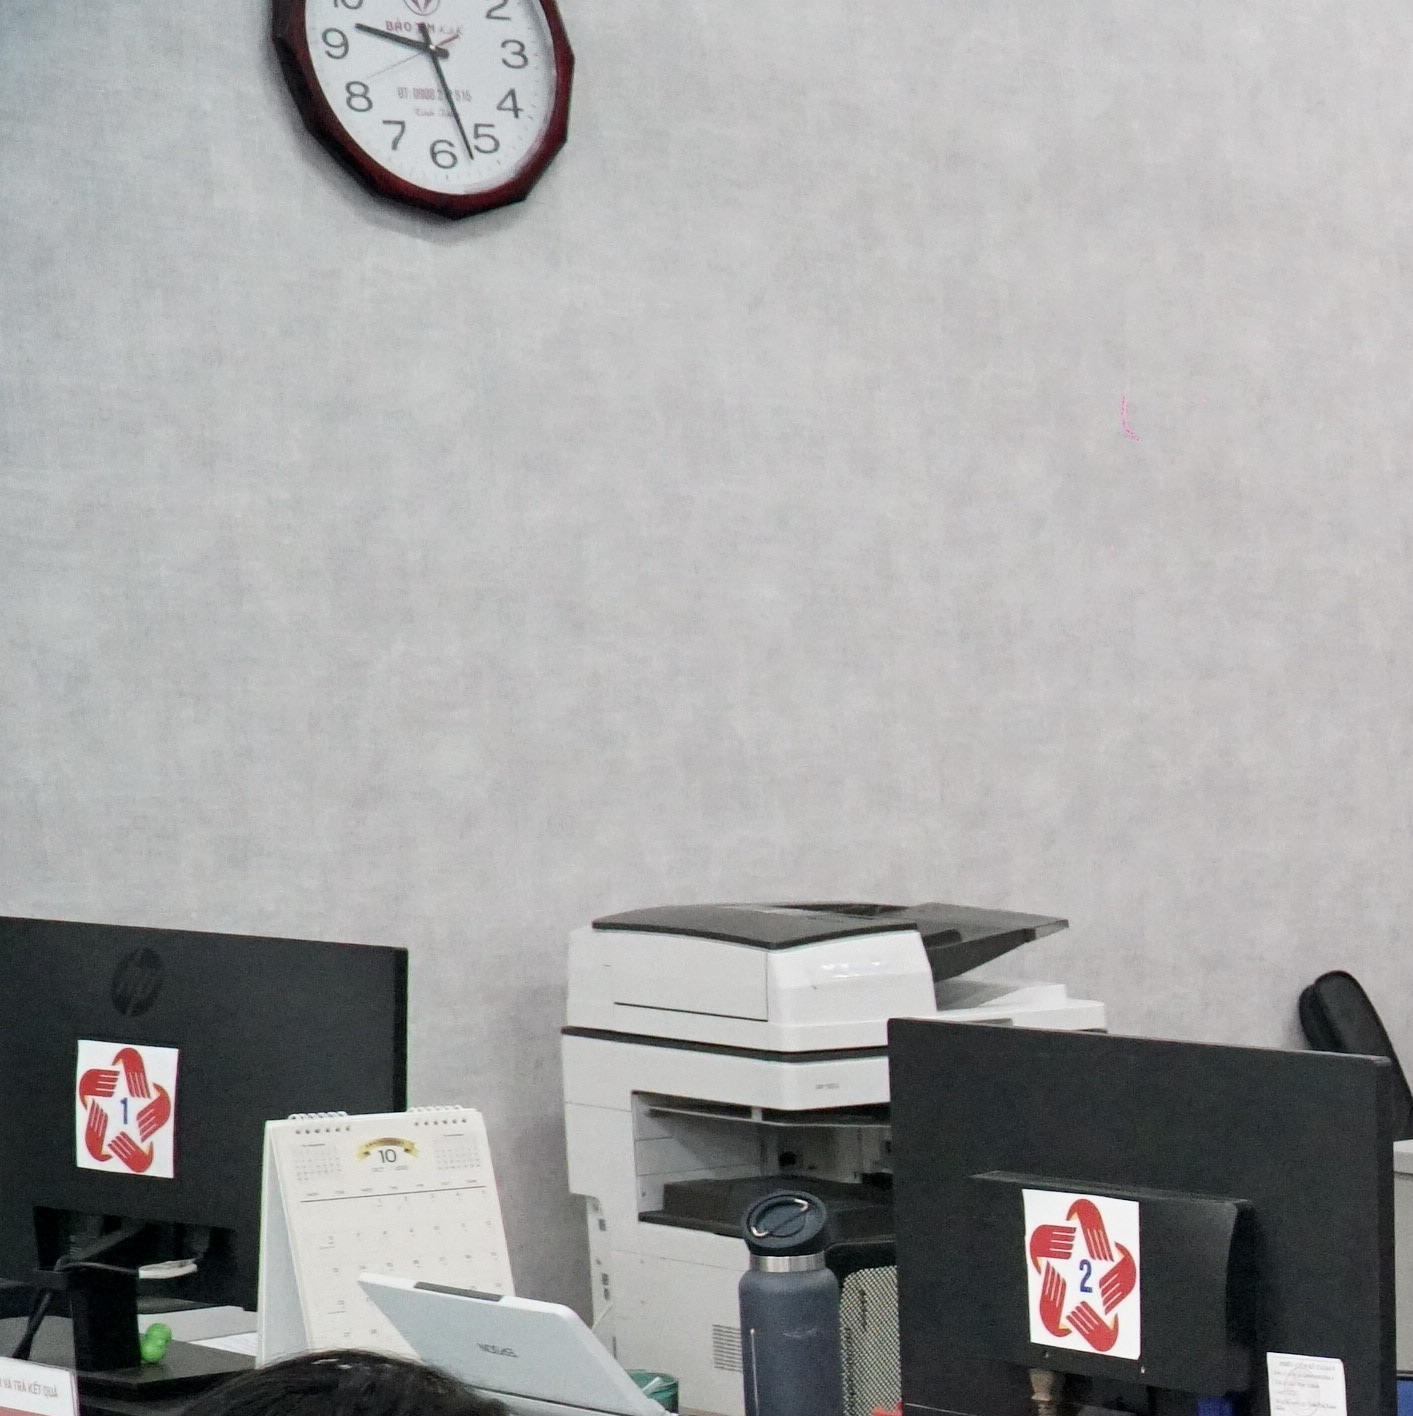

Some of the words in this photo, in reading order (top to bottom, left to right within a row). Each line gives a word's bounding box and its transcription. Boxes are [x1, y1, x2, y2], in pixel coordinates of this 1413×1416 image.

[321, 27, 349, 59] 9
[501, 39, 529, 69] 3
[346, 81, 374, 112] 8
[496, 88, 524, 119] 4
[382, 120, 407, 151] 7
[473, 123, 500, 154] 5
[430, 139, 458, 169] 6
[119, 1097, 129, 1124] 1
[378, 1149, 397, 1163] 10
[1079, 1259, 1093, 1294] 2
